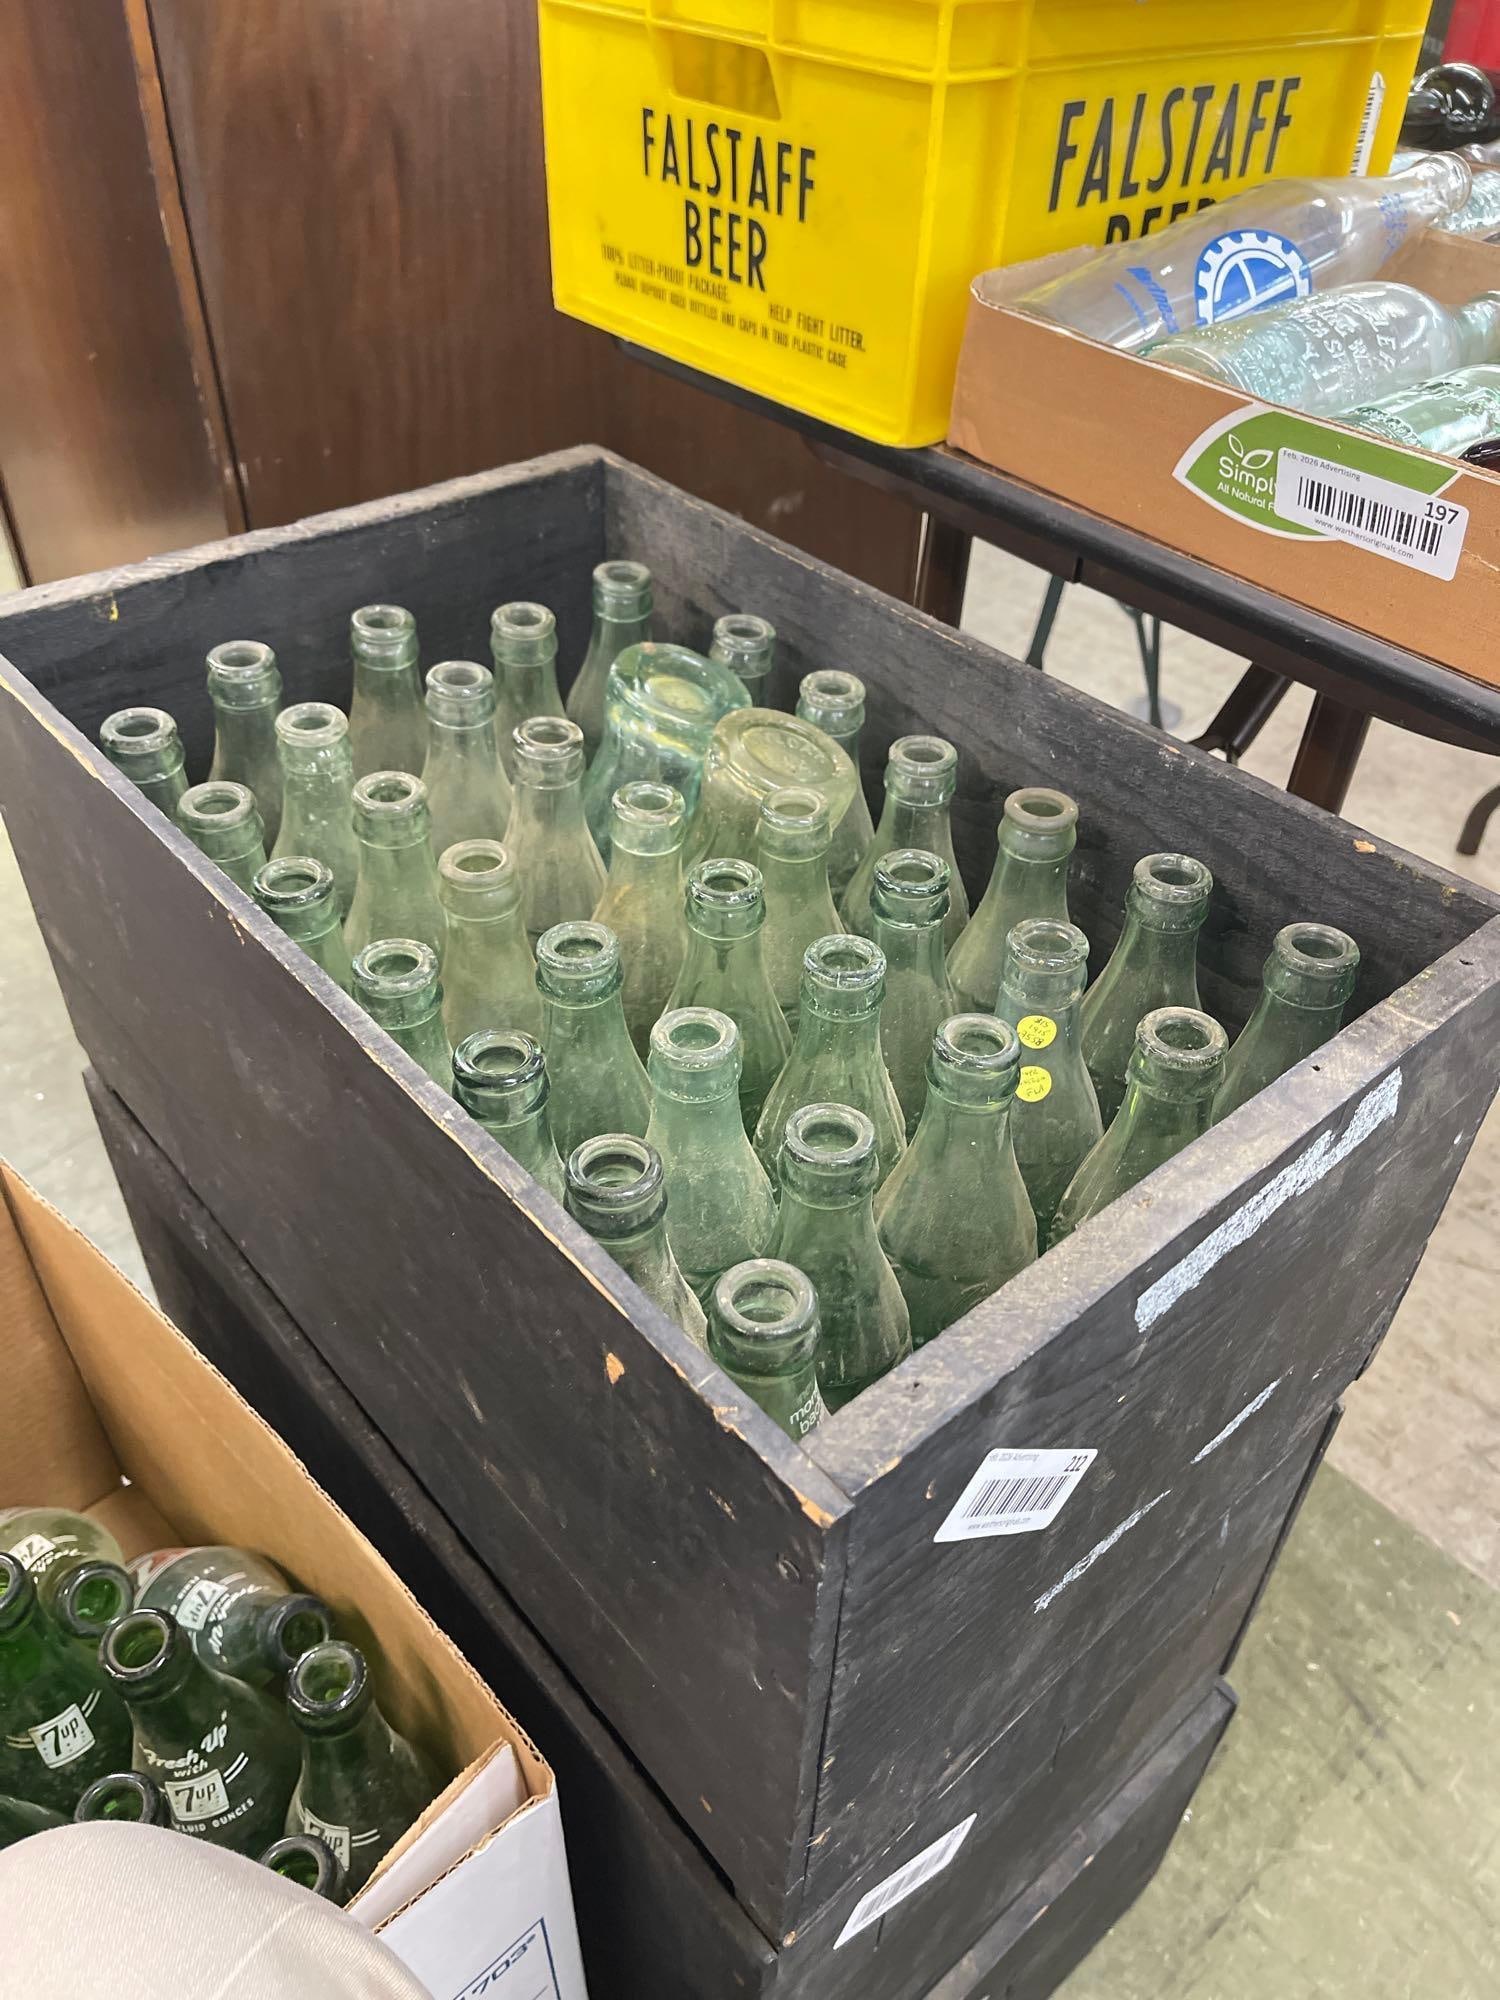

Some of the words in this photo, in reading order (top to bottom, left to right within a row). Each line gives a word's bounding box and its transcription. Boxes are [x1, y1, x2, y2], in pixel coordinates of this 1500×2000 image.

[1048, 77, 1301, 212] FALSTAFF
[642, 107, 816, 222] FALSTAFF
[685, 199, 767, 292] BEER
[769, 303, 793, 325] HELP
[796, 311, 824, 337] FIGHT
[1218, 456, 1275, 496] Simpl
[1300, 455, 1319, 467] 2026
[1320, 461, 1361, 481] Advertising
[1217, 481, 1230, 494] All
[1231, 487, 1266, 509] Natural
[1424, 501, 1459, 525] 197
[1064, 1455, 1089, 1473] 212
[174, 1759, 208, 1778] with
[211, 1797, 255, 1828] OUNCES
